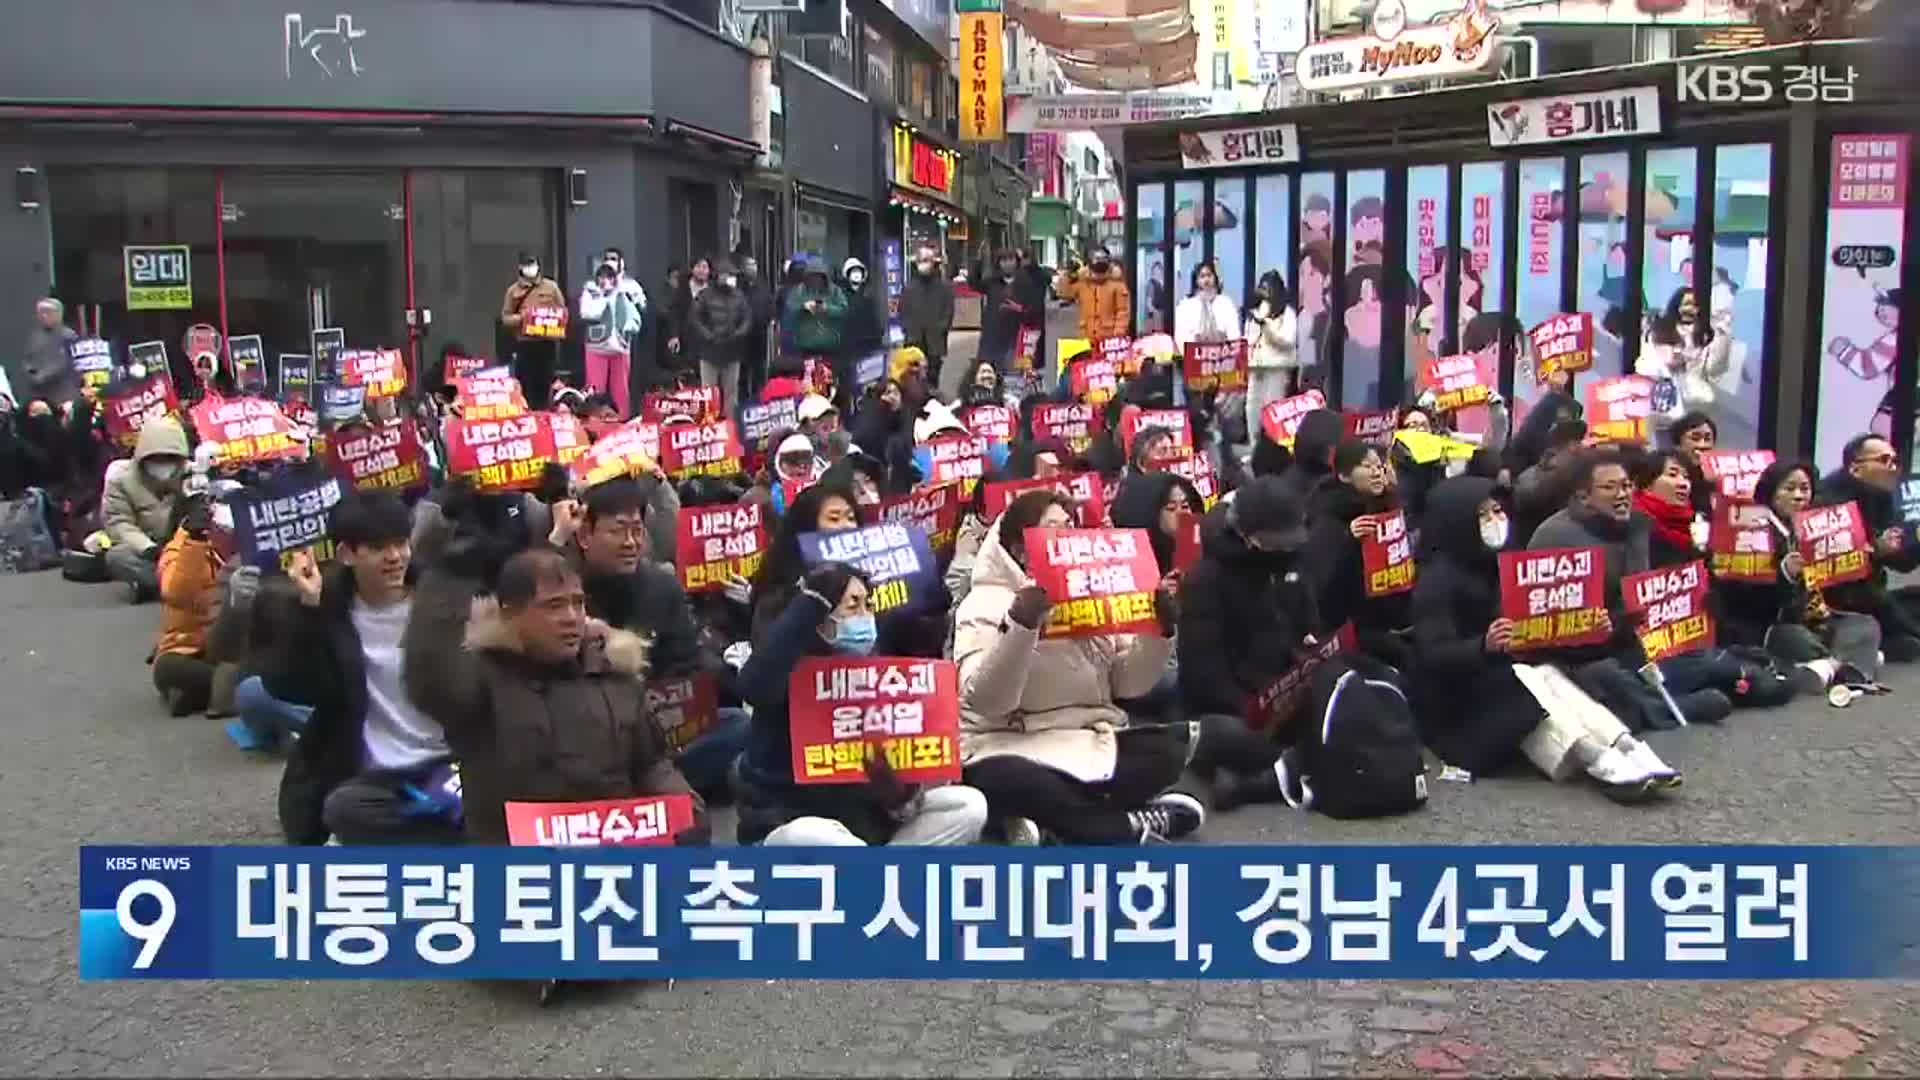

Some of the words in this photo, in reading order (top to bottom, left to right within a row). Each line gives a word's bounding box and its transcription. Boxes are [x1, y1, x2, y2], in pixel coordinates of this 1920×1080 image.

[1546, 95, 1637, 137] 홍가네
[132, 252, 184, 281] 임대
[463, 416, 537, 446] 내란수괴
[691, 504, 758, 537] 내란수괴
[705, 530, 756, 562] 윤석열
[1047, 533, 1136, 566] 내란수괴
[1517, 551, 1591, 586] 내란수괴
[1636, 564, 1698, 605] 내란수괴
[1528, 582, 1583, 615] 윤석열
[815, 664, 936, 701] 내란수괴
[832, 701, 924, 739] 윤석열
[535, 801, 668, 846] 내란수괴
